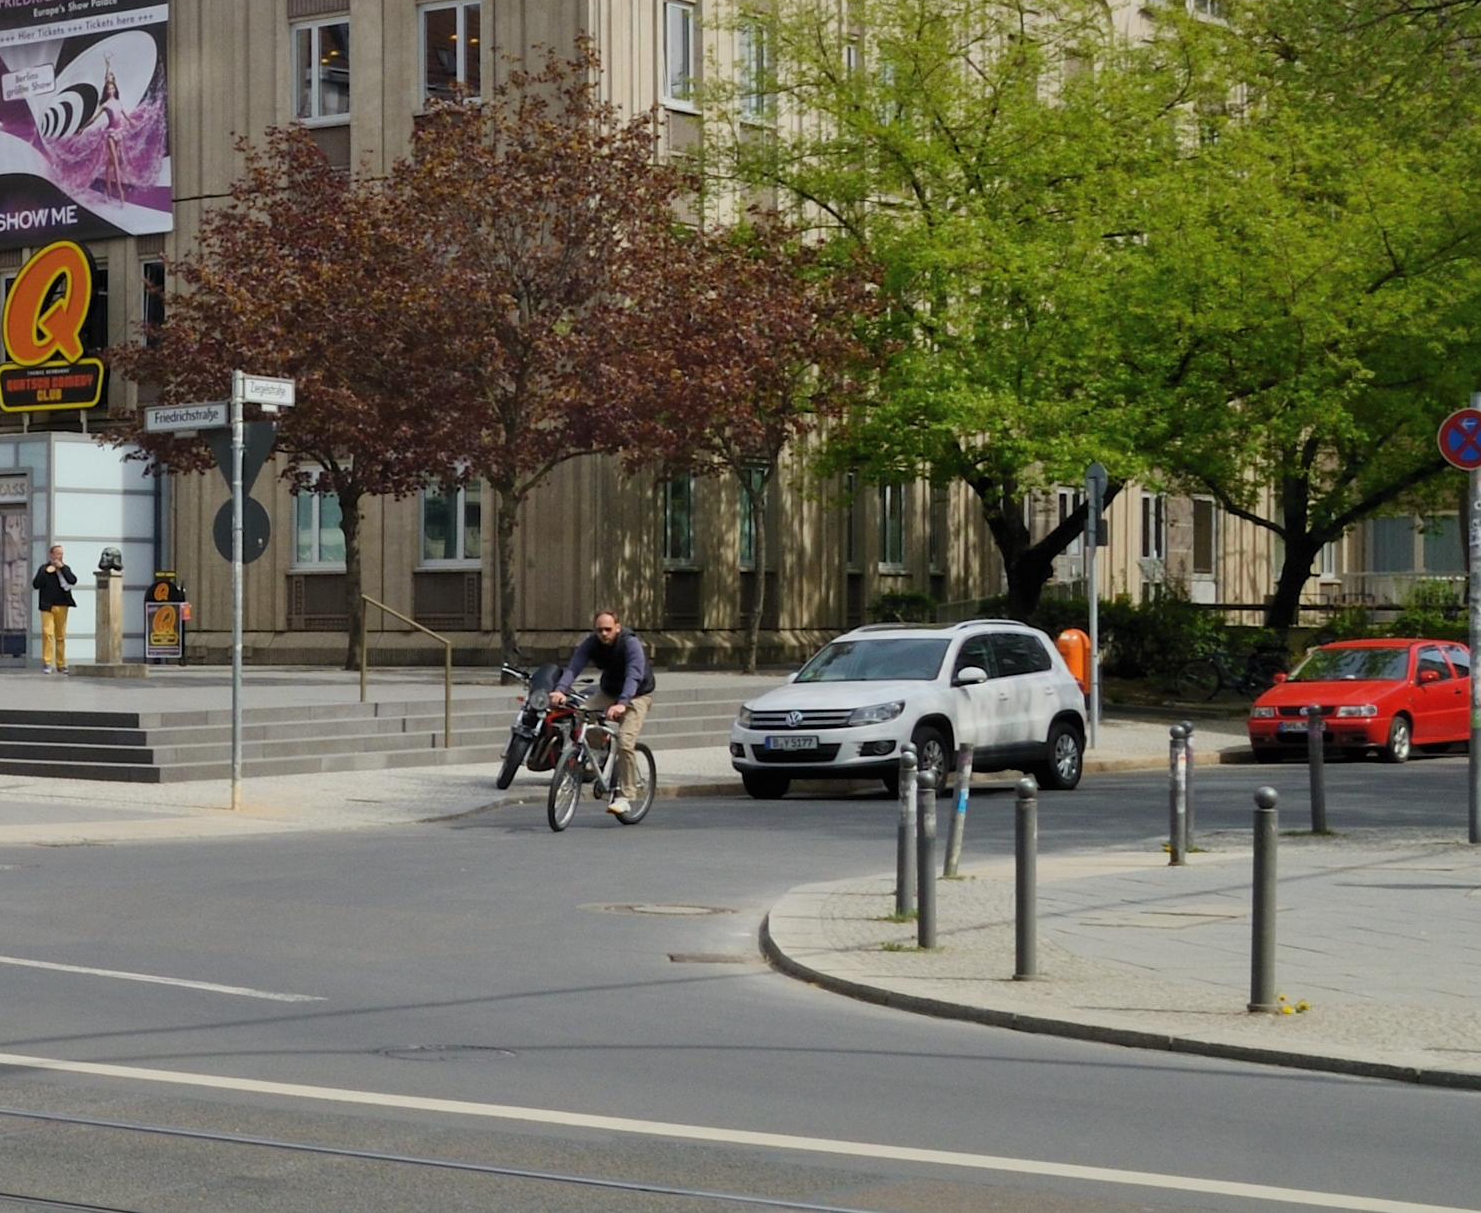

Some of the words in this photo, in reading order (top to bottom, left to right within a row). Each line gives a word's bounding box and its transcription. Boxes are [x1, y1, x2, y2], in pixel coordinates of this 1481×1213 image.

[33, 4, 65, 17] Europe's
[68, 0, 88, 12] Show
[18, 31, 35, 41] Hier
[38, 27, 64, 38] Tickets
[85, 20, 113, 31] Tickets
[117, 15, 135, 26] here
[51, 205, 78, 226] ME
[2, 240, 92, 366] Q
[37, 388, 62, 401] CLUB
[154, 407, 219, 424] Friedrichstraße
